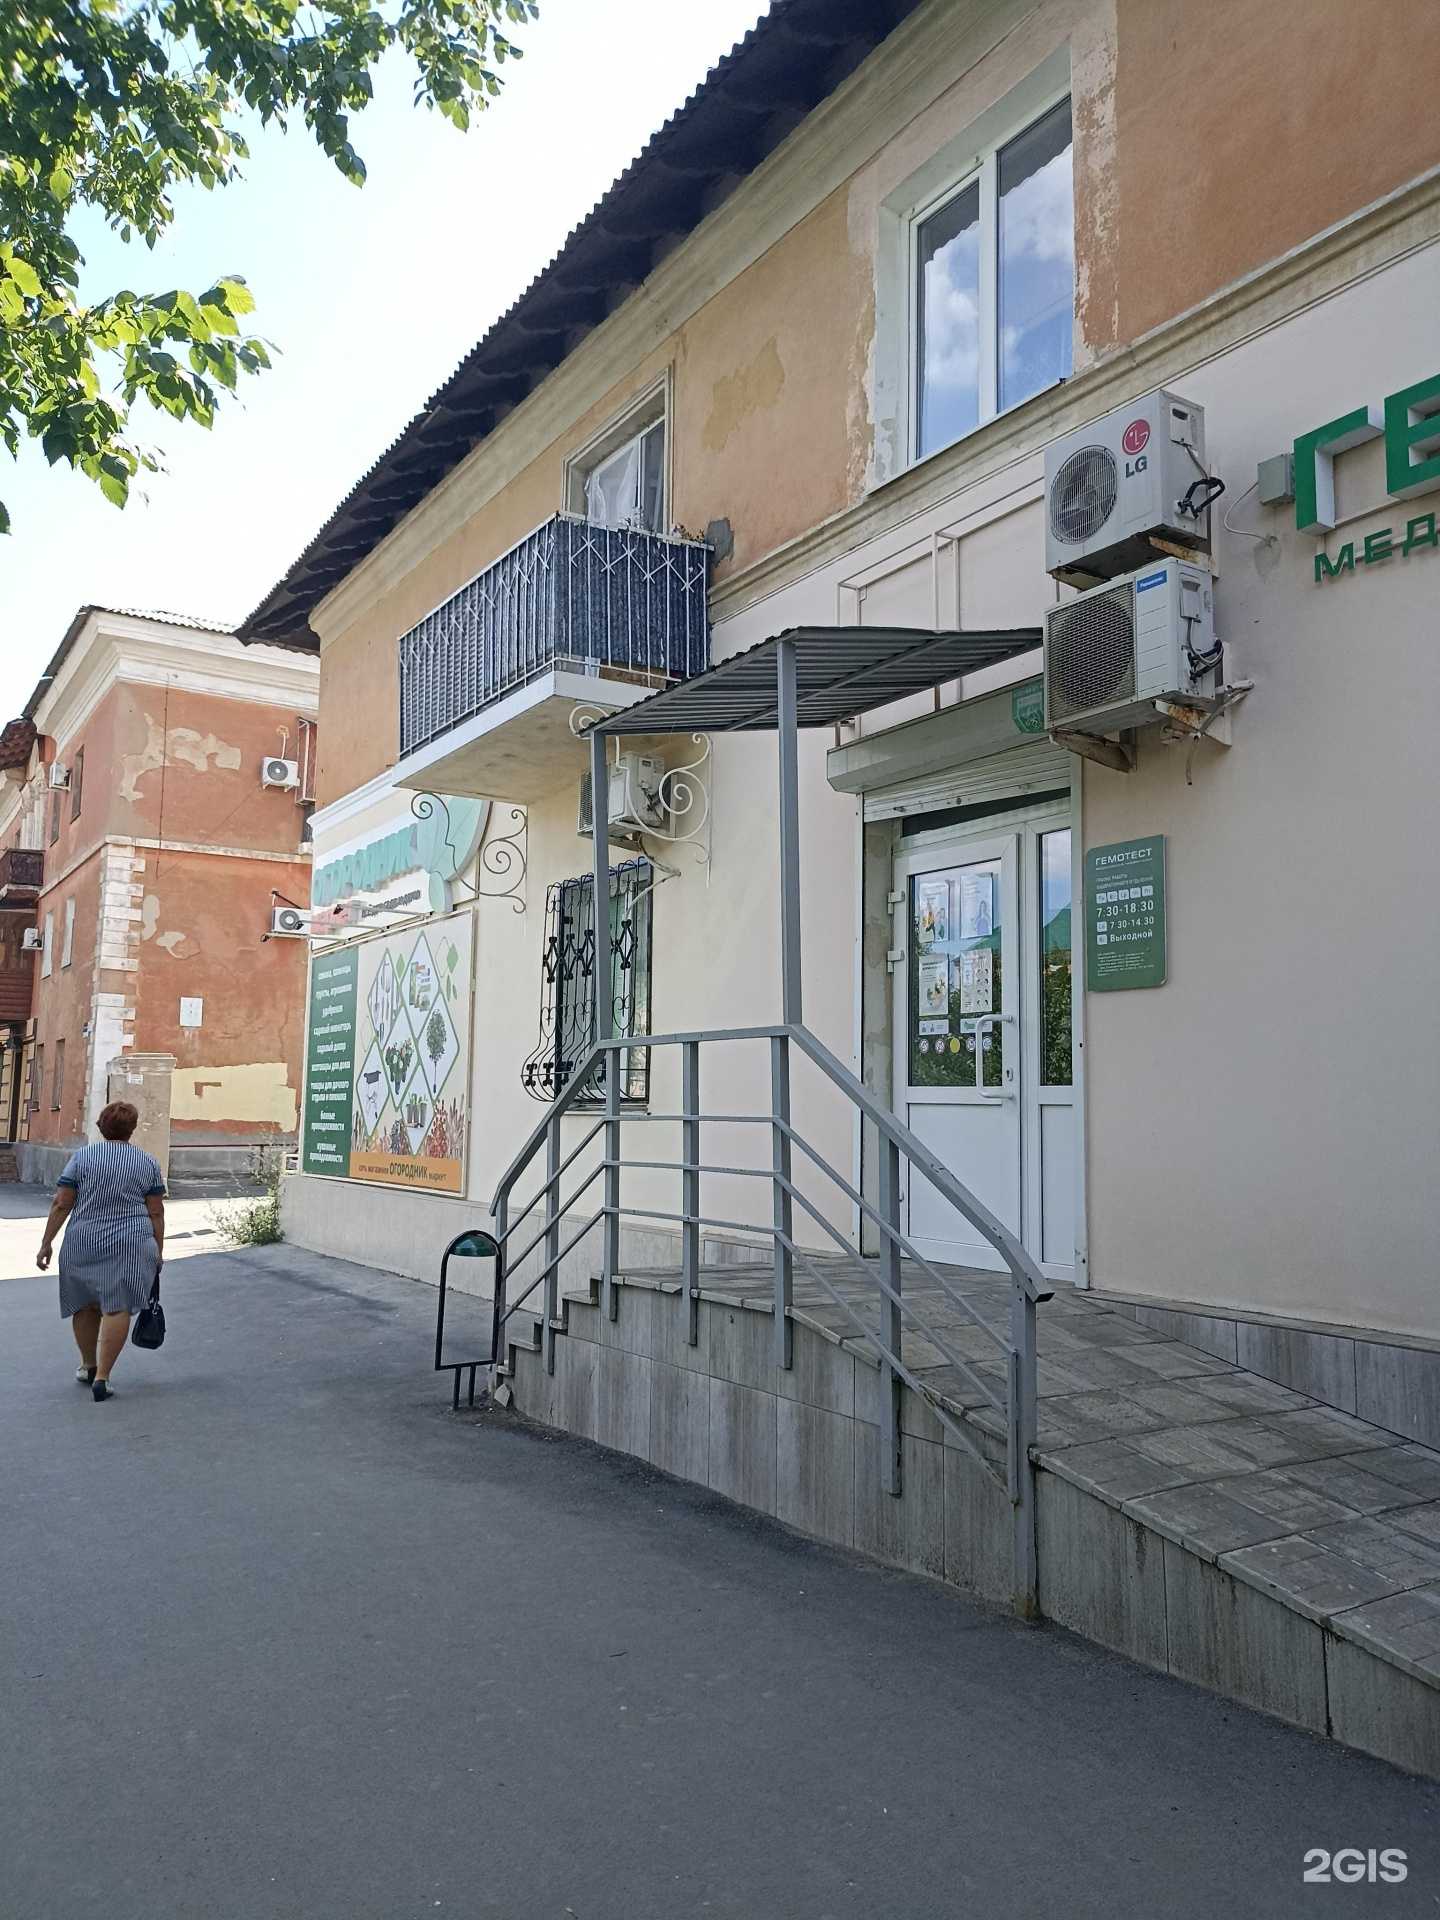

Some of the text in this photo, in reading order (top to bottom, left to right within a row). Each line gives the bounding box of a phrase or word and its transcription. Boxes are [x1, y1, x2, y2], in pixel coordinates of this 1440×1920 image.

[1125, 455, 1148, 479] LG
[1095, 848, 1152, 866] ГЕМОТЕСТ
[1109, 929, 1153, 943] Выходной
[389, 1162, 428, 1180] ОГОРОДНИК
